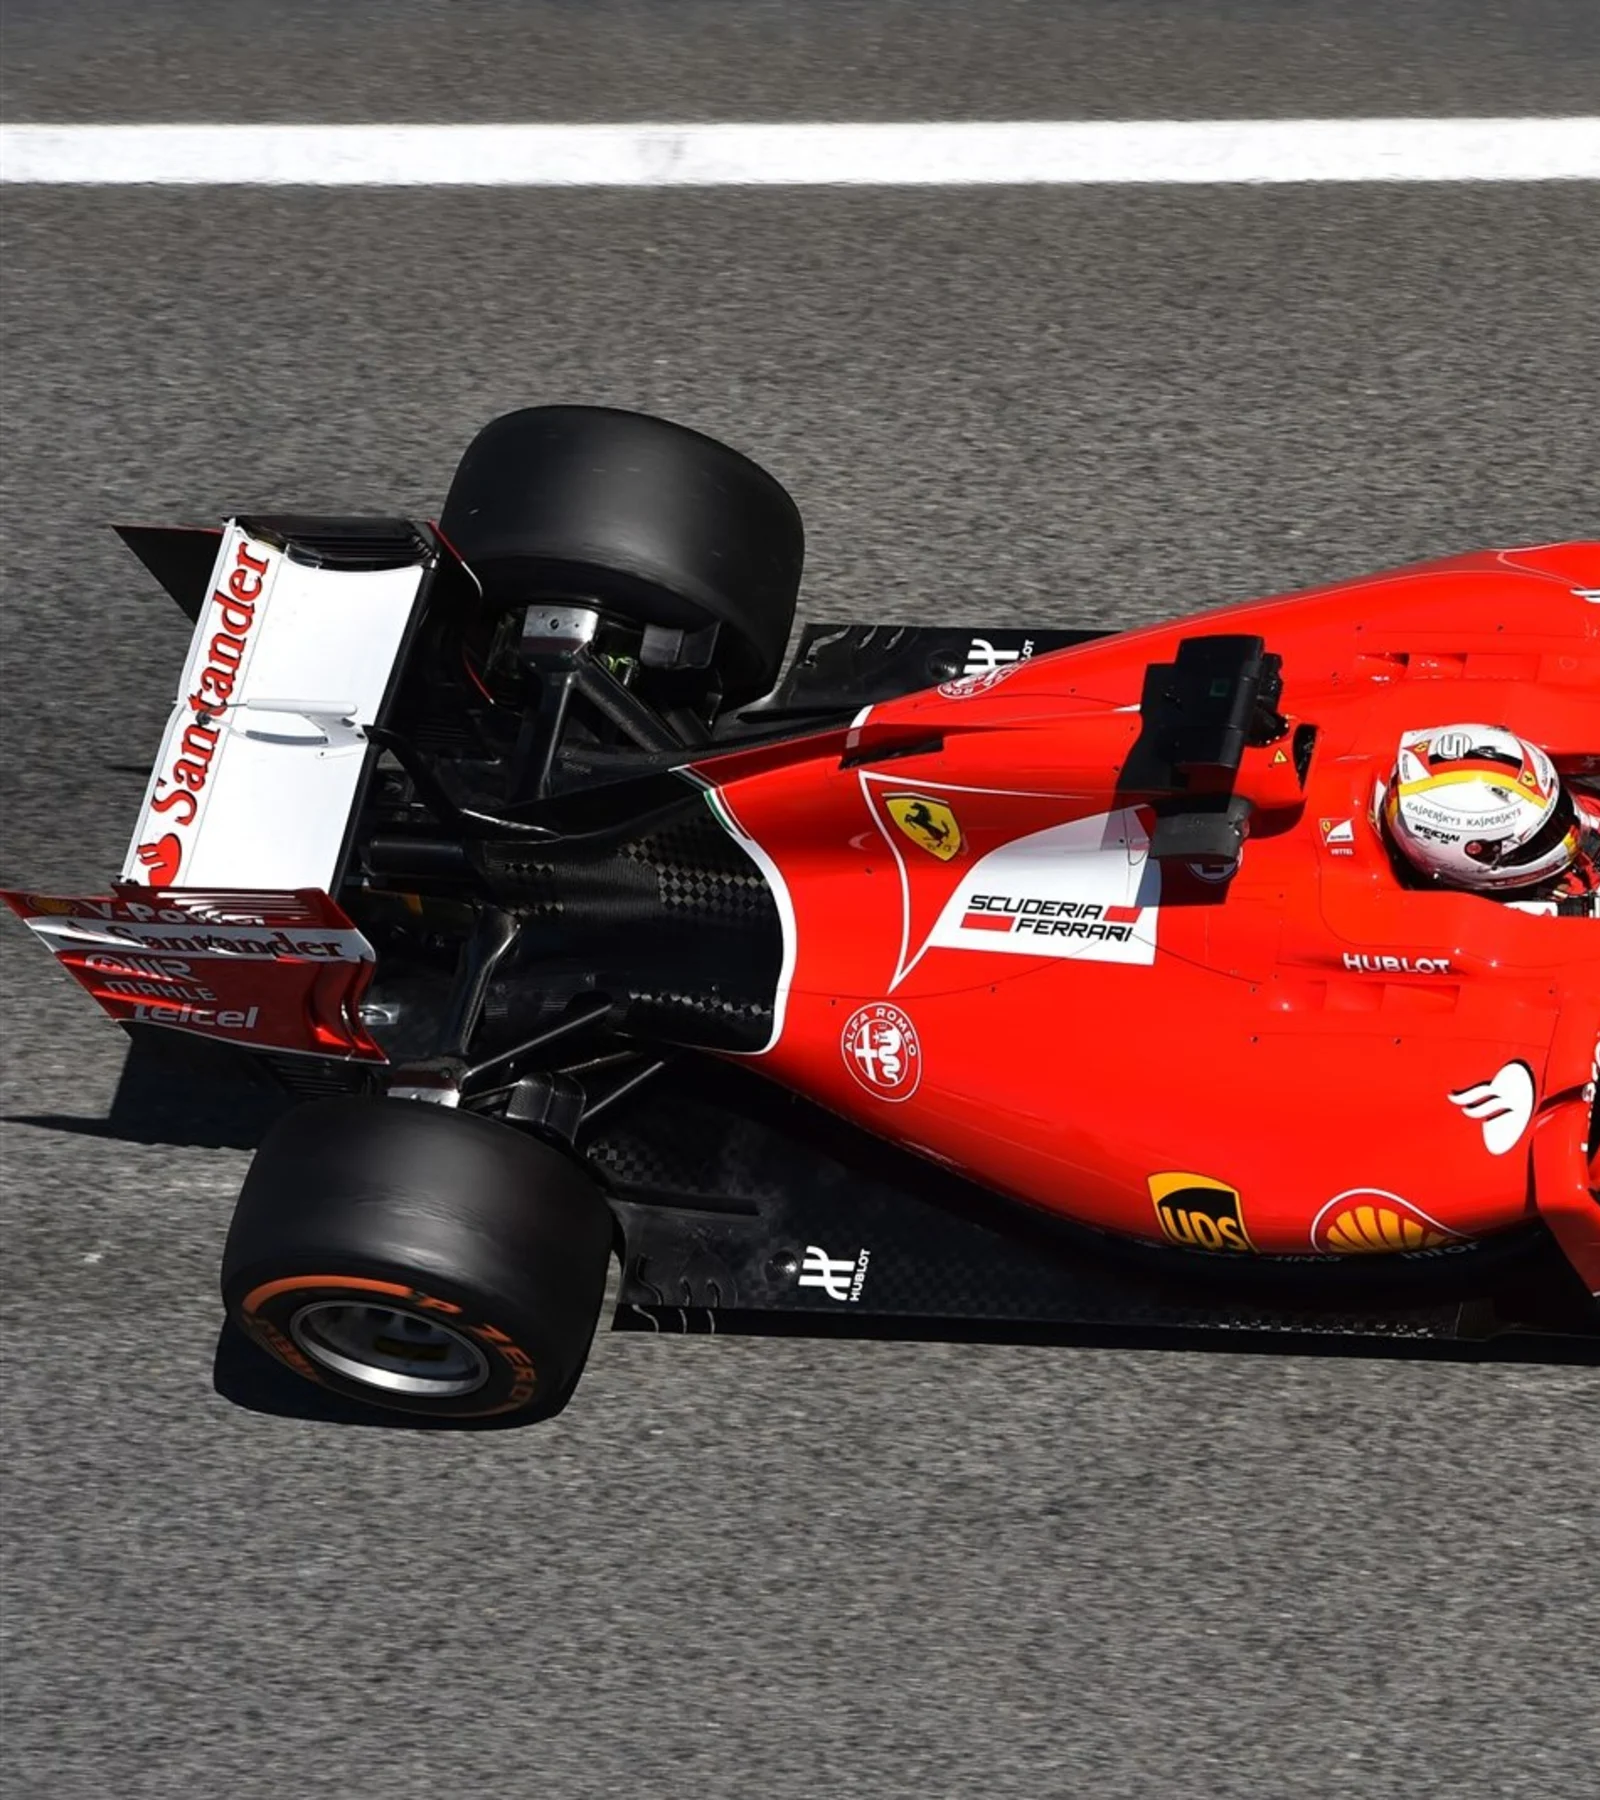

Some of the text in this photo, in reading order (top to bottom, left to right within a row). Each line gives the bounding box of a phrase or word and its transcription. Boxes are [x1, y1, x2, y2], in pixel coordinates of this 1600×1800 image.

[151, 542, 269, 826] Santander
[1415, 824, 1460, 842] WEICHAI
[968, 895, 1103, 920] SCUDERIA
[106, 925, 347, 957] Santander
[1015, 918, 1133, 942] FERRARI
[1343, 952, 1449, 974] HUBLOT
[105, 981, 217, 1001] MAHLE
[845, 1008, 917, 1056] ALFA ROMEO
[849, 1248, 871, 1302] HUBLOT
